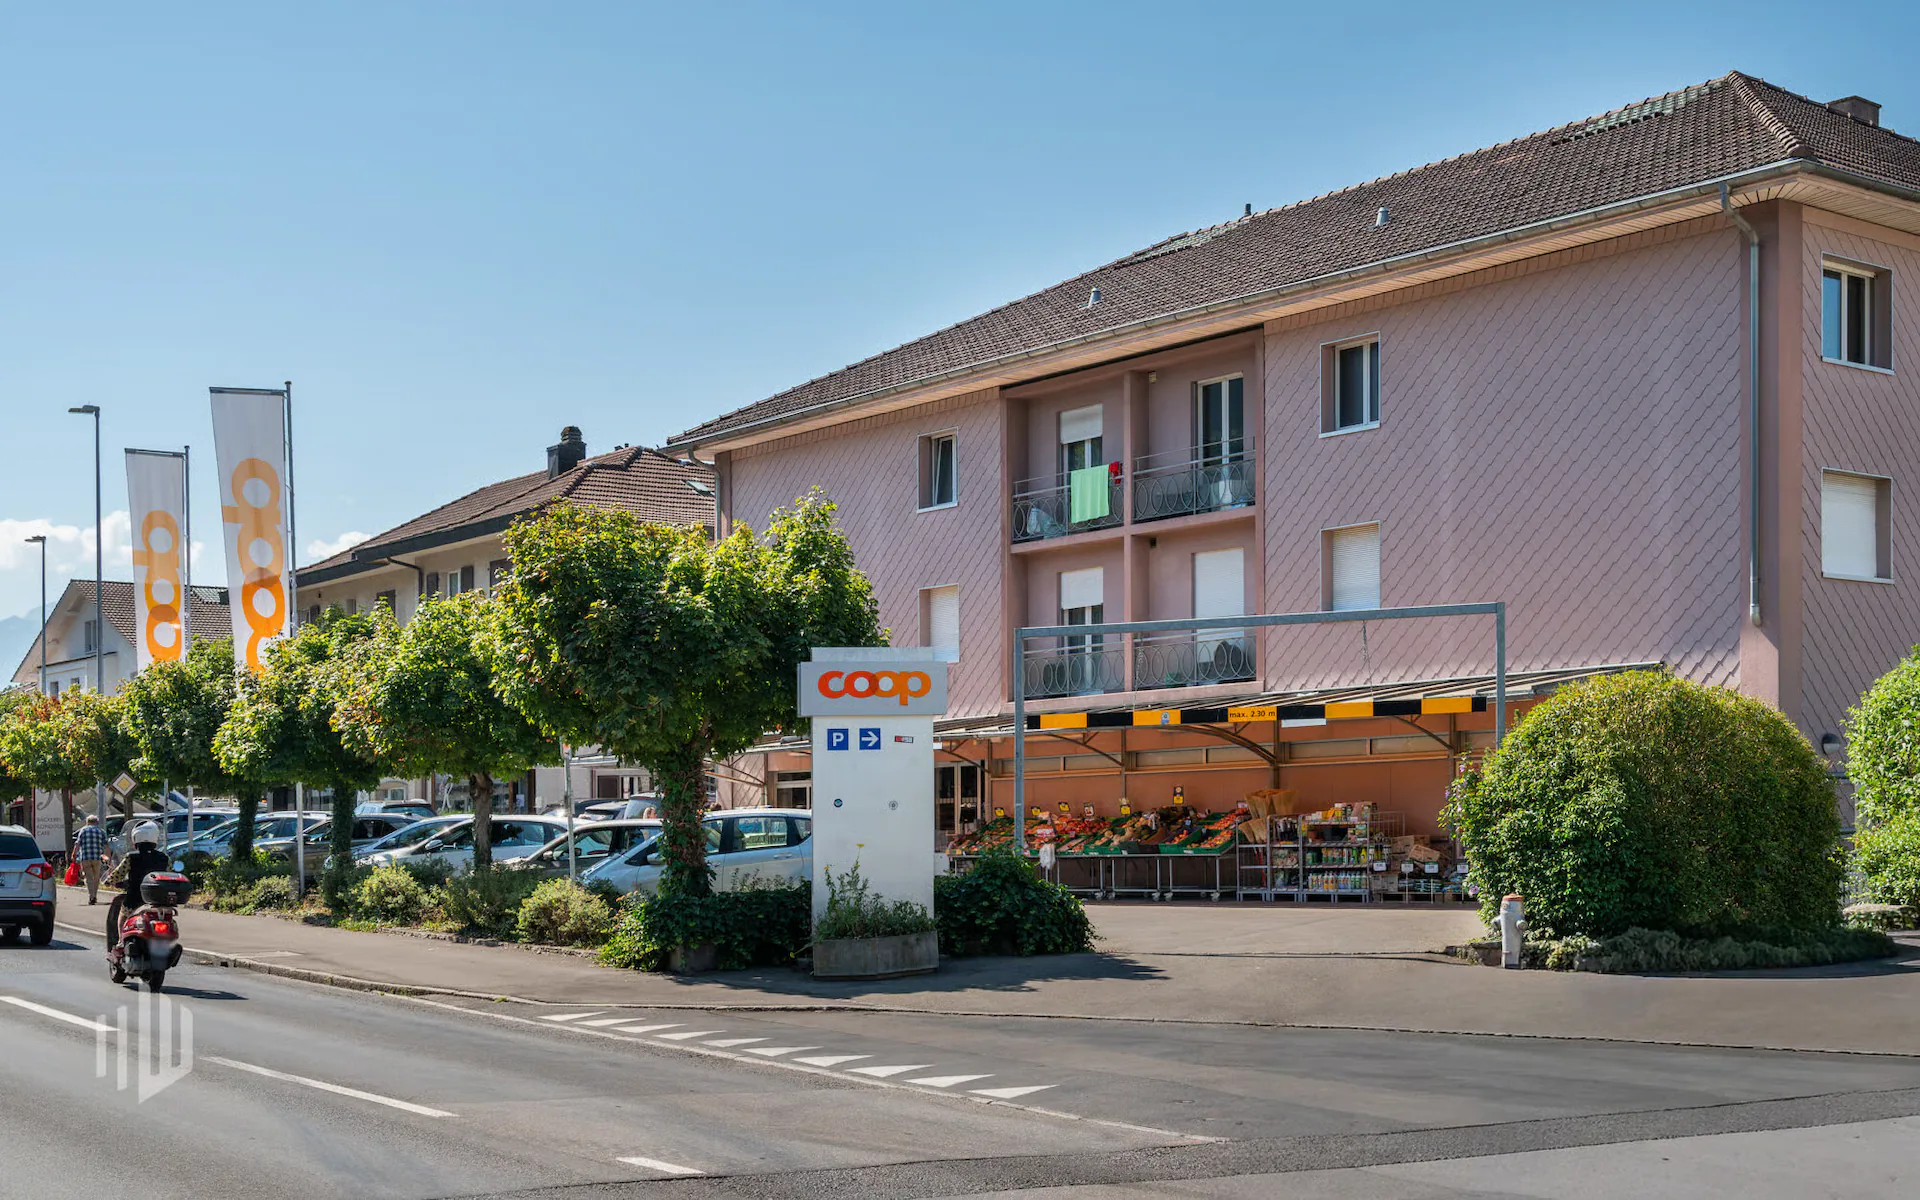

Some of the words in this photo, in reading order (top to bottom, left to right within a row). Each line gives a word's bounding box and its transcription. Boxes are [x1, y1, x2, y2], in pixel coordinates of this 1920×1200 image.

[817, 670, 932, 706] coop
[1250, 710, 1266, 718] 2.30
[832, 732, 845, 747] P
